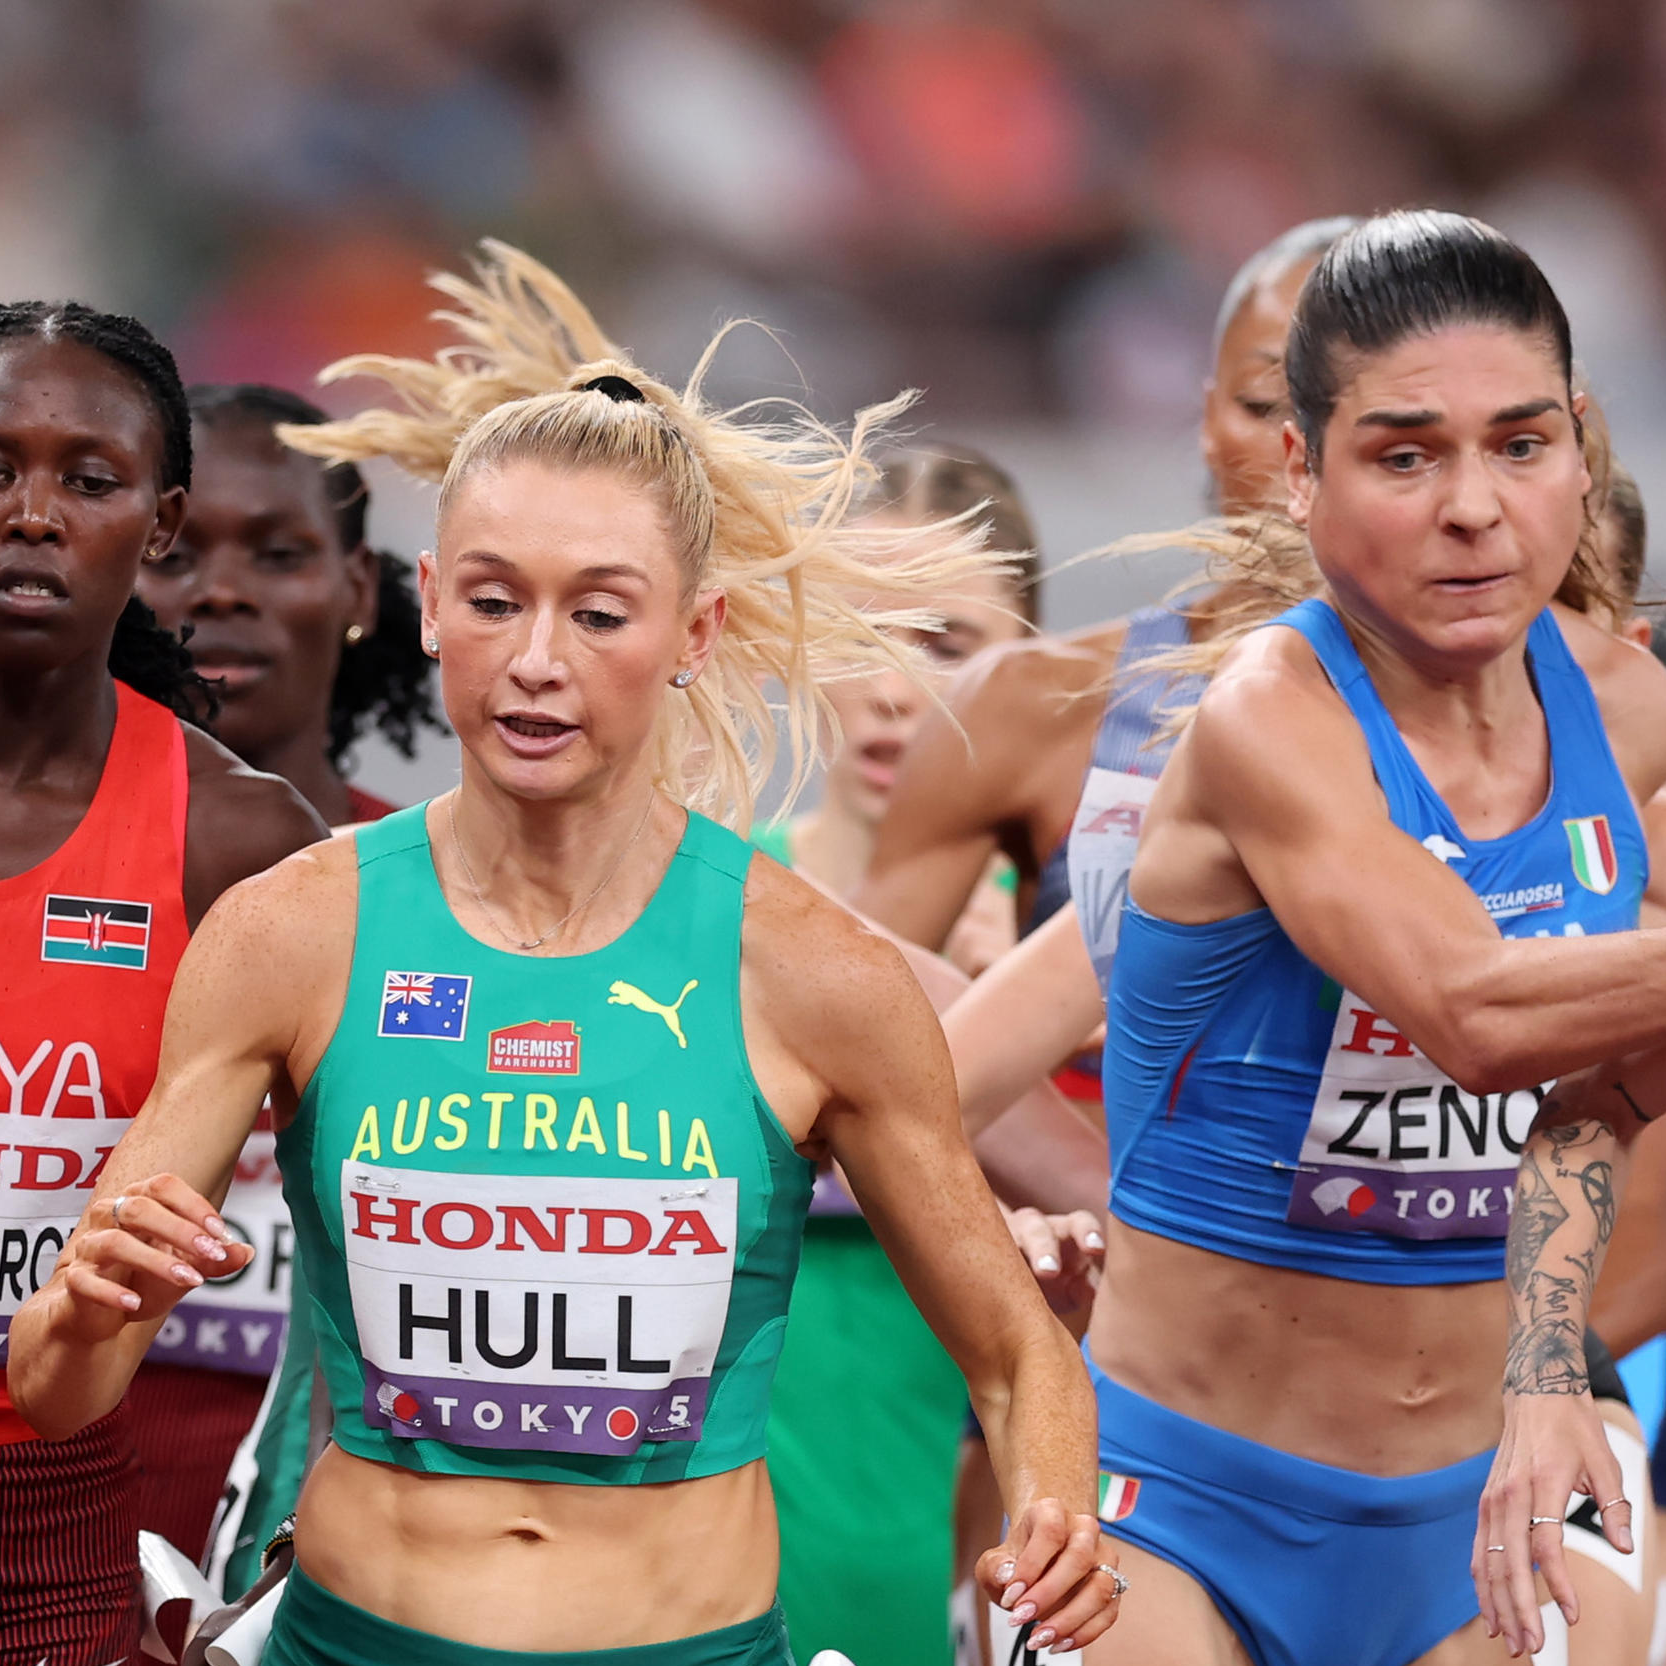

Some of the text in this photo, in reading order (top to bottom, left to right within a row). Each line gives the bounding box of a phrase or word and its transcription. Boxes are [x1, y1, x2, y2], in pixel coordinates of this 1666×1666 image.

[1480, 882, 1564, 911] CCIAROSSA
[493, 1056, 572, 1069] WAREHOUSE
[494, 1036, 575, 1058] CHEMIST
[349, 1092, 720, 1179] AUSTRALIA
[350, 1191, 727, 1256] HONDA
[399, 1283, 671, 1373] HULL
